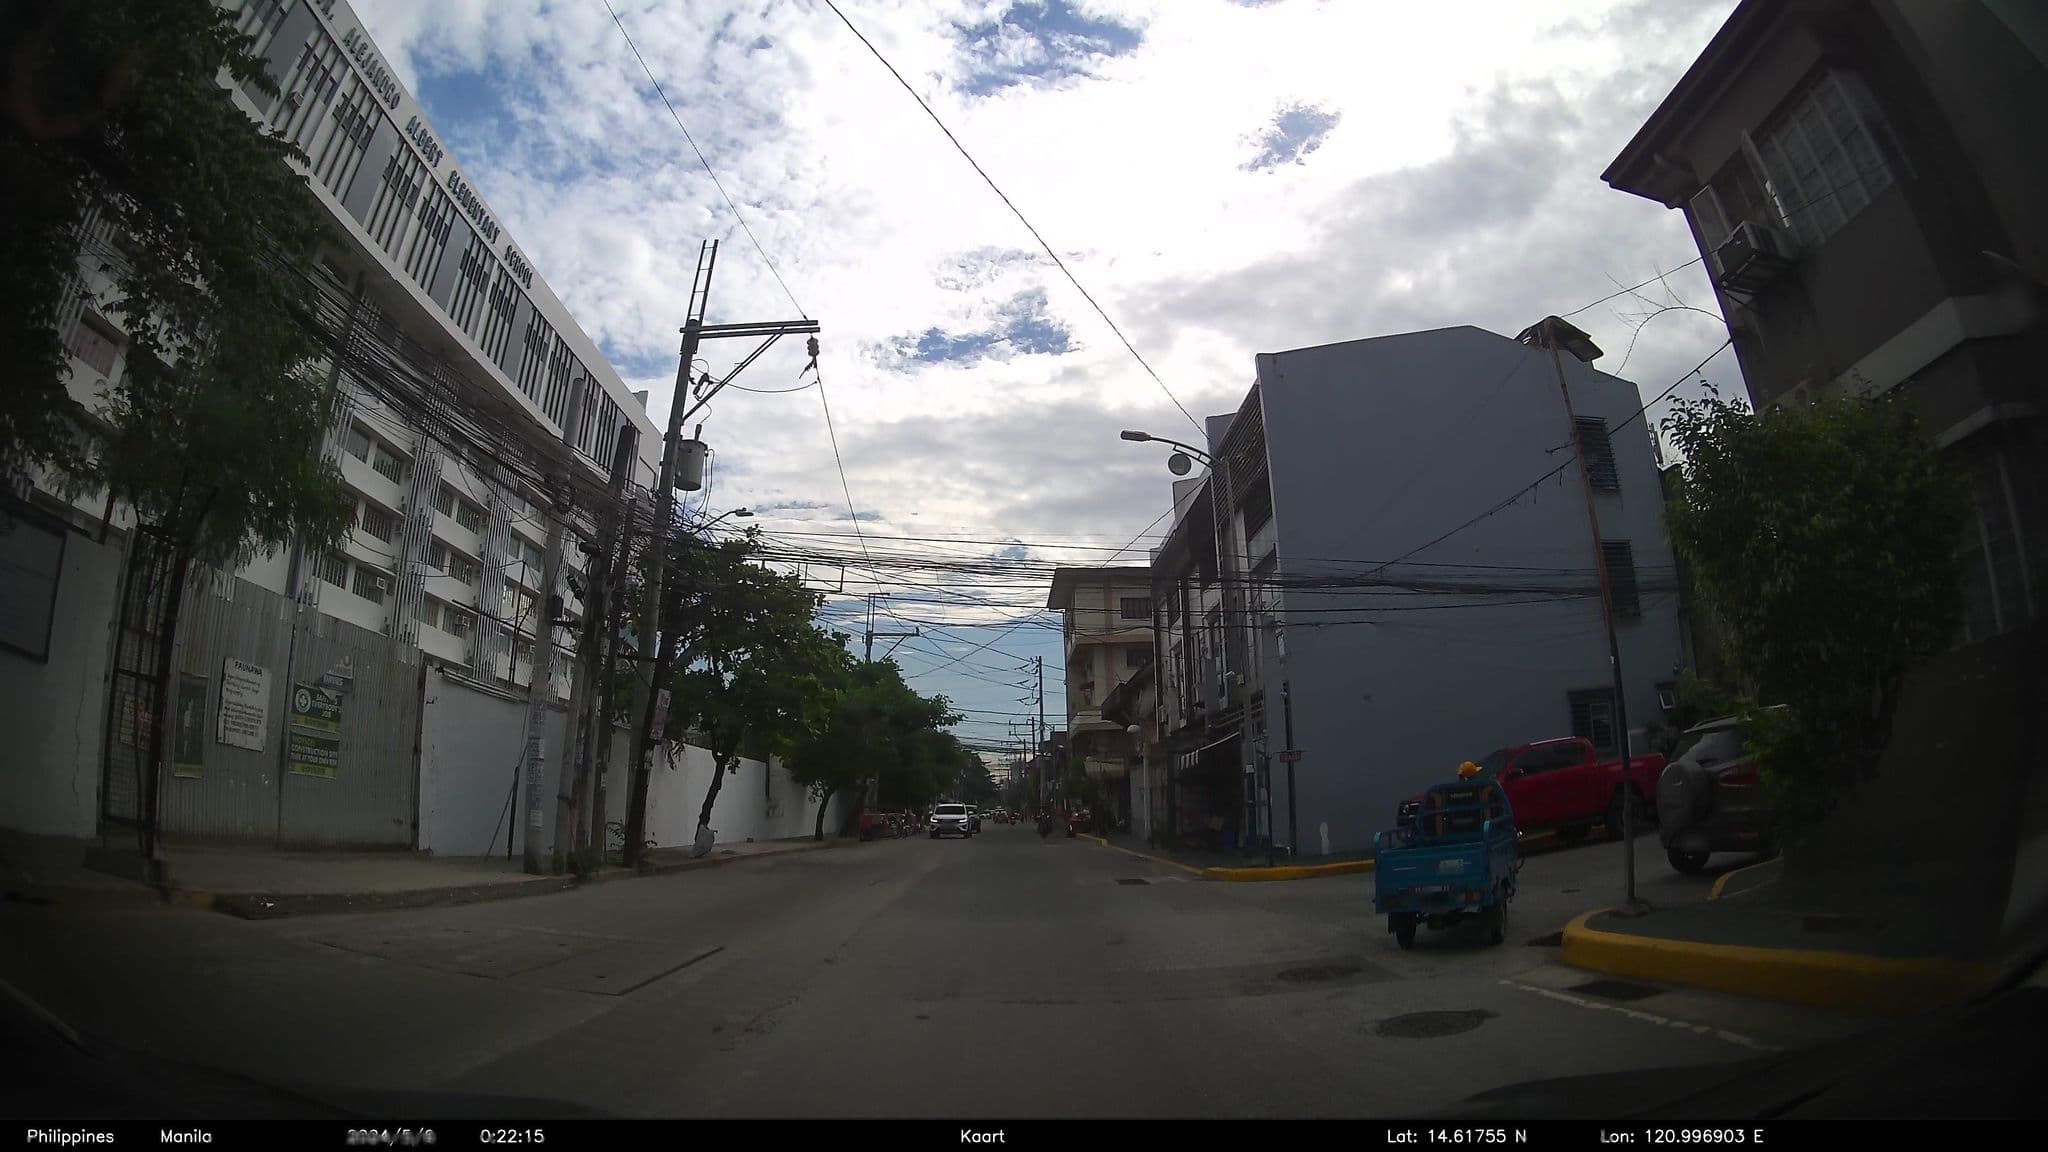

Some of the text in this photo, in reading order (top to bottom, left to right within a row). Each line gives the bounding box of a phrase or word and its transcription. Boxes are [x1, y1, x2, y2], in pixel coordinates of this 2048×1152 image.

[404, 114, 444, 168] ALBERT
[448, 169, 501, 245] ELEMENTARY
[503, 244, 534, 290] SCHOOL
